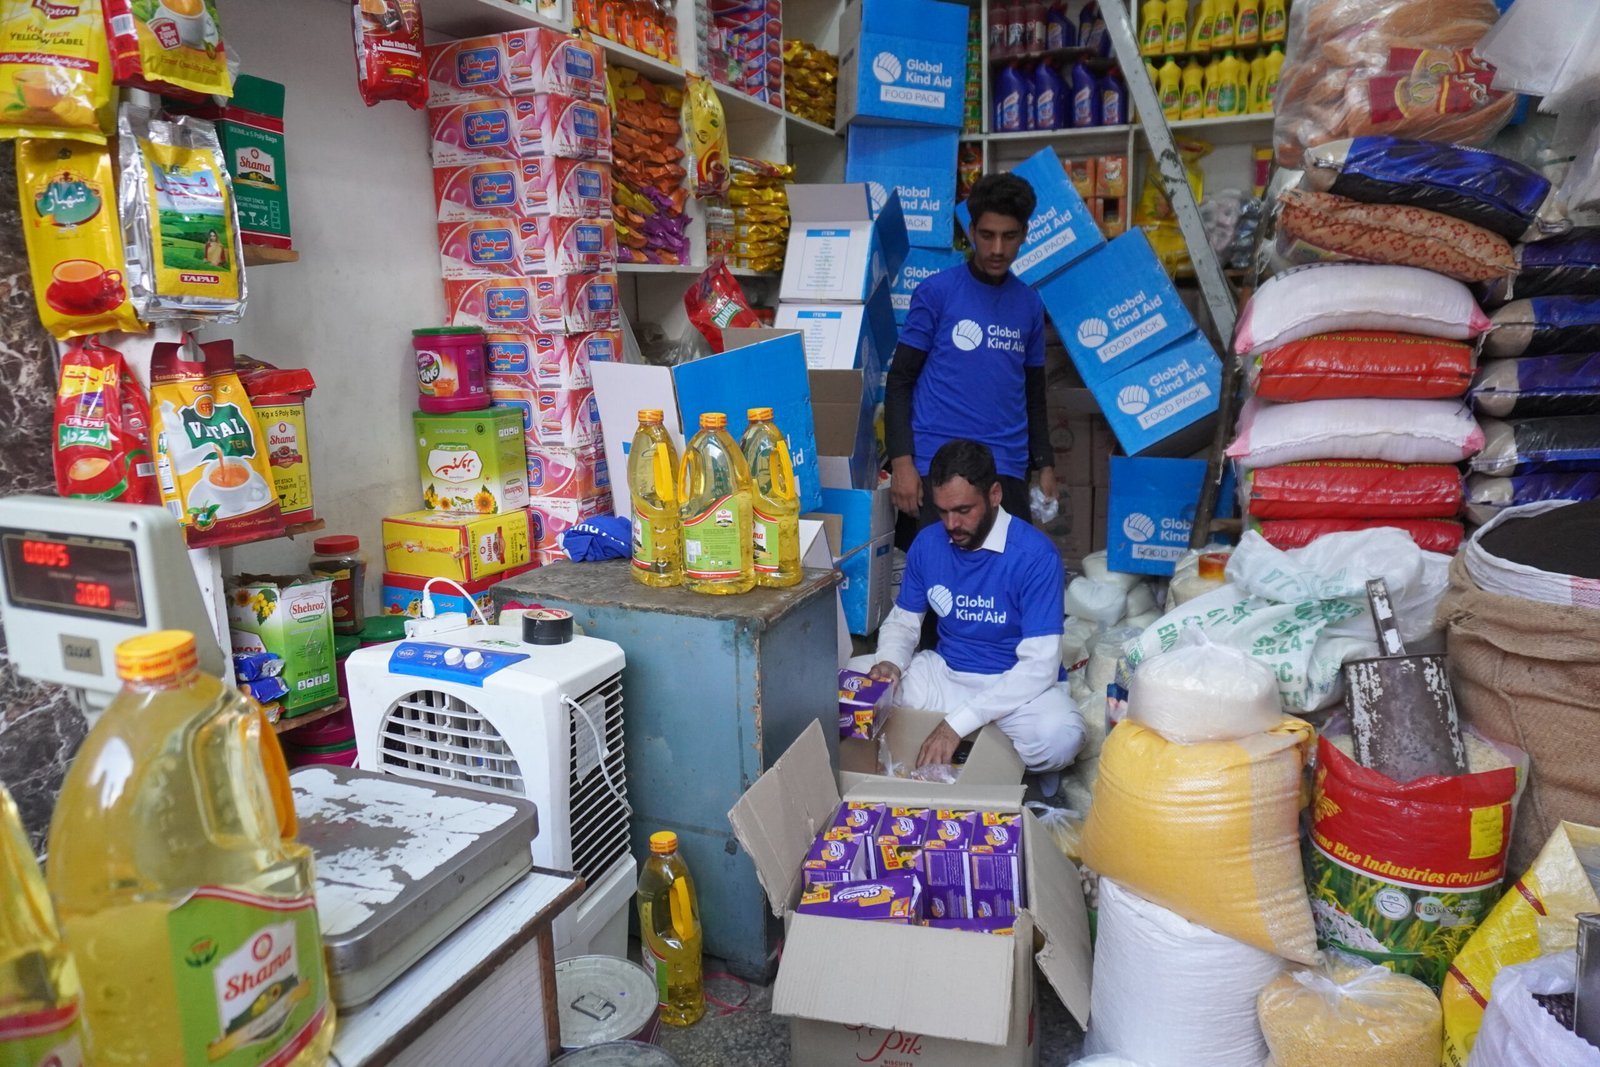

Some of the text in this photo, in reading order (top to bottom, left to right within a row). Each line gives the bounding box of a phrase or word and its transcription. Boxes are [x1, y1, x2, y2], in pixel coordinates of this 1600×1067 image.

[10, 32, 84, 47] YELLOW LABEL
[905, 59, 943, 74] Global
[905, 72, 952, 88] Kind Aid
[884, 87, 941, 104] FOOD PACK
[265, 134, 278, 144] Bags
[239, 155, 271, 173] Shama
[899, 200, 941, 211] ind Aid
[1026, 206, 1058, 232] lobal
[1026, 209, 1074, 246] Kind Aid
[1015, 233, 1071, 272] FOOD PACK
[183, 275, 219, 283] TAPAL
[1107, 290, 1147, 321] Global
[1112, 294, 1164, 331] Kind Aid
[987, 324, 1021, 339] Global
[1101, 318, 1161, 359] FOOD PACK
[987, 337, 1011, 351] Kind
[420, 367, 438, 383] TANG
[1149, 359, 1190, 388] Global
[1154, 362, 1207, 399] Kind Aid
[261, 411, 269, 419] Kg
[279, 410, 289, 418] Poly
[290, 409, 301, 417] Bags
[1143, 388, 1205, 425] FOOD PACK
[188, 418, 244, 440] VITAL
[229, 440, 248, 449] TEA
[269, 434, 296, 446] Shama
[792, 448, 804, 467] id
[1161, 518, 1193, 530] Glob
[1161, 530, 1189, 543] Kind
[23, 540, 70, 568] 0005
[1137, 546, 1190, 559] FOOD PA
[75, 581, 111, 609] 200
[956, 595, 995, 609] Global
[291, 600, 325, 616] Shehroz
[956, 609, 1007, 624] Kind Aid
[1334, 841, 1360, 863] Rice
[1363, 854, 1449, 884] Industries
[1446, 874, 1473, 885] (Pvt)
[224, 944, 293, 1003] Shama
